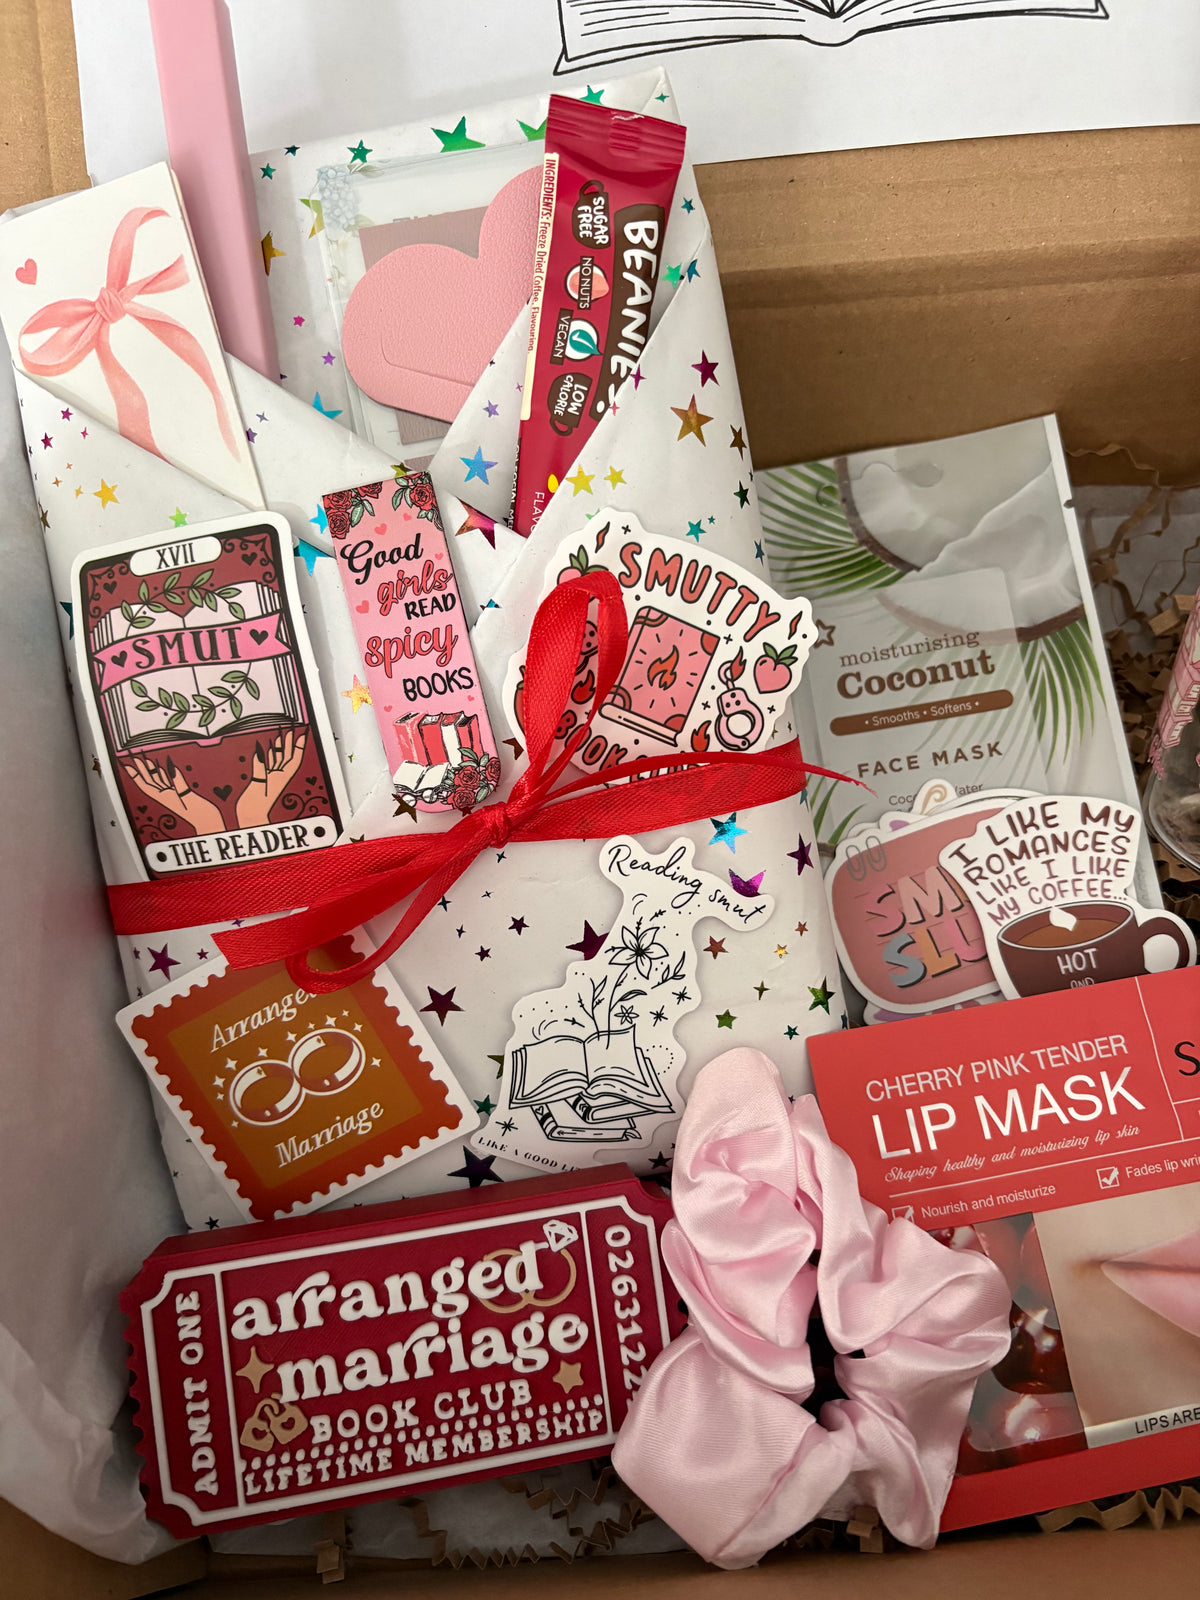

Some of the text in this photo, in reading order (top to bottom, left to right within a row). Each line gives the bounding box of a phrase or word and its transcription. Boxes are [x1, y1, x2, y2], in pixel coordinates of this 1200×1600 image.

[541, 159, 557, 219] INGREDIENTS:
[538, 221, 551, 249] Freeze
[577, 205, 593, 239] FREE
[593, 196, 609, 245] SUGAR
[535, 251, 547, 274] Dried
[579, 257, 593, 309] NO NUTS
[552, 315, 571, 358] VEGAN
[553, 375, 574, 417] CALORIE
[567, 383, 588, 416] LOW
[155, 542, 197, 570] XVII
[340, 533, 424, 585] Good
[376, 559, 454, 616] girls
[404, 592, 457, 620] READ
[618, 541, 782, 642] SMUTTY
[132, 626, 243, 670] SMUT
[365, 624, 459, 678] spicy
[838, 631, 981, 668] moisturising
[402, 666, 474, 702] BOOKS
[836, 649, 996, 699] Coconut
[871, 700, 973, 727] Smooths Softens
[856, 741, 1004, 778] FACE MASK
[955, 783, 984, 796] ater
[168, 825, 310, 867] THE READER
[948, 801, 1135, 869] I LIKE MY
[962, 829, 1131, 886] ROMANCES
[608, 844, 767, 924] Reading smut
[976, 855, 1130, 906] LIKE I LIKE
[986, 878, 1128, 926] MY COFFEE...
[1056, 948, 1097, 975] HOT
[210, 988, 318, 1053] Arrange
[865, 1034, 1129, 1102] CHERRY PINK TENDER
[274, 1102, 384, 1169] Marriage
[871, 1066, 1147, 1160] LIP MASK
[478, 1136, 508, 1152] LIKE
[523, 1152, 558, 1168] GOOD
[884, 1124, 1141, 1182] Shaping healthy and moisturizing lip skin
[1125, 1162, 1163, 1179] Fades
[1164, 1159, 1179, 1173] lip
[921, 1183, 1057, 1219] Nourish and moisturize
[230, 1239, 544, 1341] arranged
[604, 1224, 648, 1410] 0263122
[276, 1311, 589, 1403] marriage
[175, 1290, 219, 1496] ADMIT ONE
[309, 1378, 533, 1444] BOOK CLUB
[1135, 1407, 1200, 1434] LIPS ARE
[244, 1408, 604, 1496] LIFETIME MEMBERSHIP
